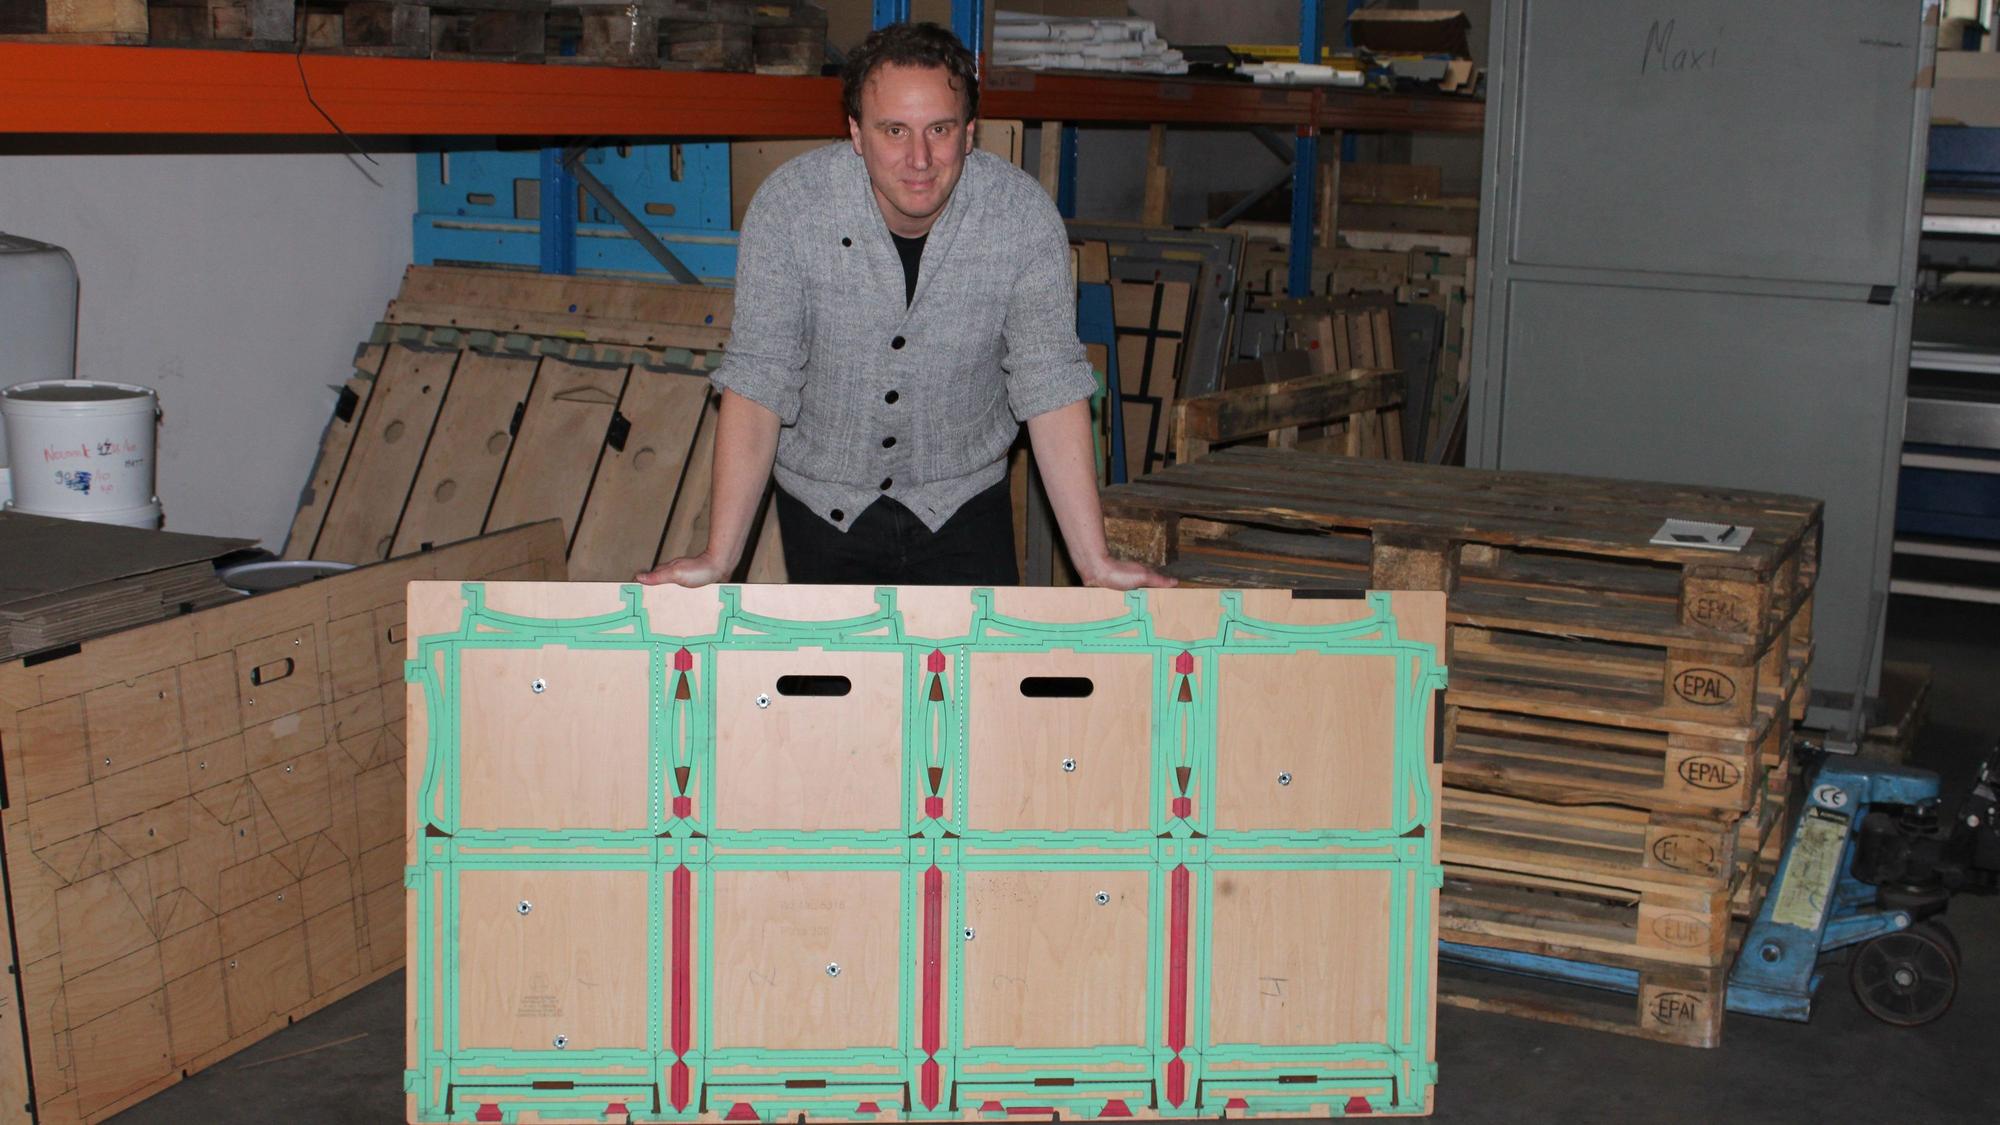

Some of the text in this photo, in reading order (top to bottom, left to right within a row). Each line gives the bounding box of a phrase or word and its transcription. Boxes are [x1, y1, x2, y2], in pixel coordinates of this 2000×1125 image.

[1641, 18, 1725, 76] Maxi
[1697, 598, 1740, 622] EPAL
[1683, 675, 1726, 700] EPAL
[1689, 761, 1730, 784] EPAL
[1820, 787, 1843, 806] CE
[1664, 917, 1699, 943] EUR
